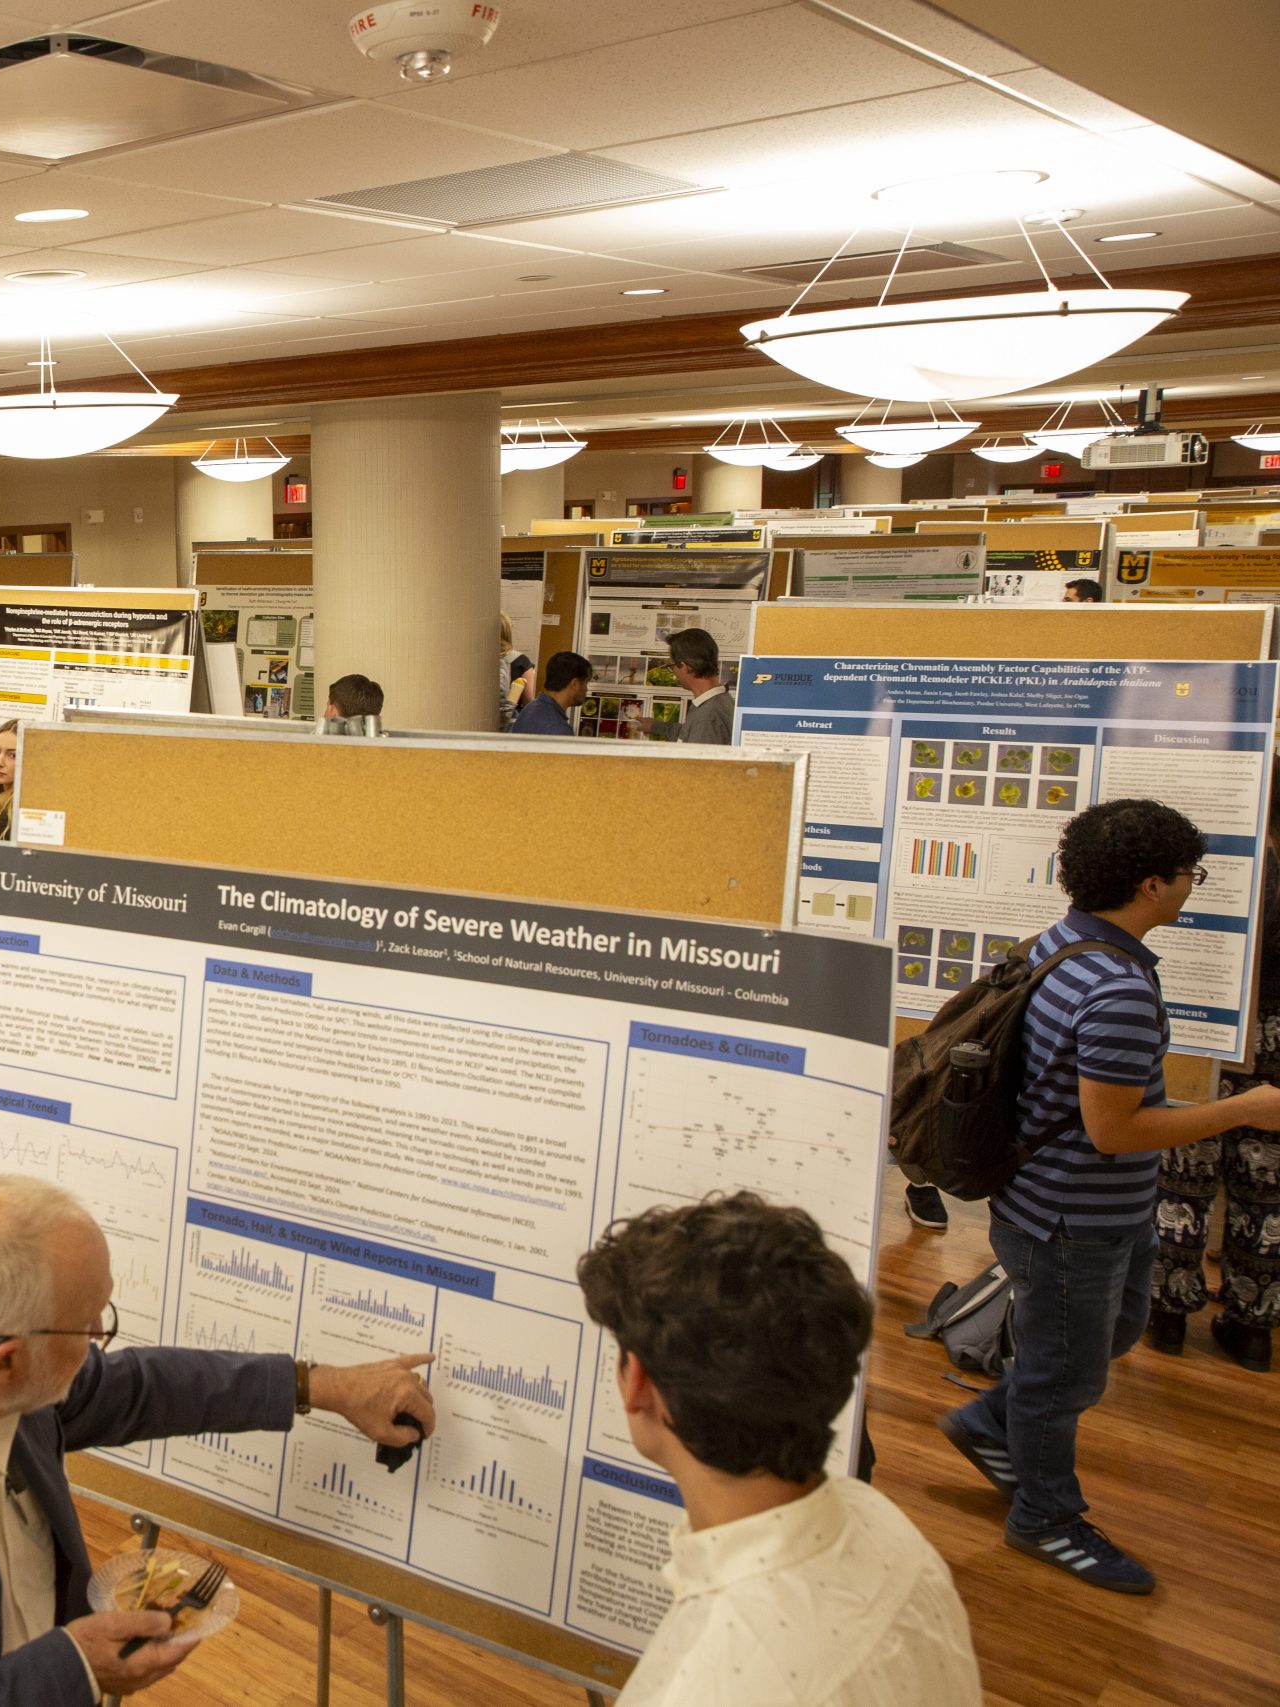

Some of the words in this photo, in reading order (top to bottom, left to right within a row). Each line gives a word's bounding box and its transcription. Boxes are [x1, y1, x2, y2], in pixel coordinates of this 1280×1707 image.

[472, 4, 499, 23] FIRE
[351, 13, 376, 35] FIRE
[113, 611, 132, 620] during
[133, 612, 154, 621] hypoxia
[834, 661, 898, 673] Characterizing
[901, 663, 950, 672] Chromatin
[951, 663, 995, 675] Assembly
[998, 665, 1028, 673] Factor
[1031, 665, 1090, 675] Capabilities
[1092, 666, 1103, 674] of
[1105, 666, 1121, 674] the
[774, 674, 812, 682] PURDUE
[823, 673, 867, 683] dependent
[870, 674, 918, 683] Chromatin
[920, 675, 968, 684] Remodeler
[971, 676, 1013, 685] PICKLE
[1015, 677, 1046, 686] (PKL)
[1048, 677, 1058, 686] in
[1060, 678, 1117, 688] Arabidopsis
[1119, 679, 1162, 688] thaliana
[796, 720, 832, 729] Abstract
[982, 726, 1016, 736] Results
[1153, 733, 1210, 745] Discussion
[0, 871, 85, 905] University
[88, 883, 108, 903] of
[112, 885, 188, 913] Missouri
[218, 884, 256, 909] The
[260, 890, 389, 930] Climatology
[394, 906, 420, 929] of
[423, 908, 504, 940] Severe
[510, 918, 621, 954] Weather
[627, 931, 652, 959] in
[660, 936, 781, 974] Missouri
[218, 920, 239, 932] Evan
[239, 922, 266, 937] Cargill
[388, 942, 411, 955] Zack
[492, 955, 503, 967] of
[504, 957, 543, 972] Natural
[545, 963, 601, 981] Resources,
[603, 970, 659, 990] University
[661, 978, 674, 990] of
[675, 979, 725, 998] Missouri
[734, 986, 790, 1007] Columbia
[212, 963, 238, 977] Data
[240, 967, 250, 979] &
[252, 969, 301, 988] Methods
[640, 1026, 714, 1053] Tornadoes
[718, 1039, 730, 1054] &
[733, 1041, 790, 1065] Climate
[27, 1099, 59, 1116] Trends
[201, 1207, 248, 1232] Tornado,
[251, 1219, 274, 1238] Hail,
[278, 1227, 287, 1240] &
[290, 1229, 327, 1252] Strong
[330, 1238, 361, 1258] Wind
[362, 1248, 409, 1273] Reports
[411, 1258, 422, 1273] in
[426, 1261, 480, 1288] Missouri
[592, 1463, 675, 1498] Conclusions
